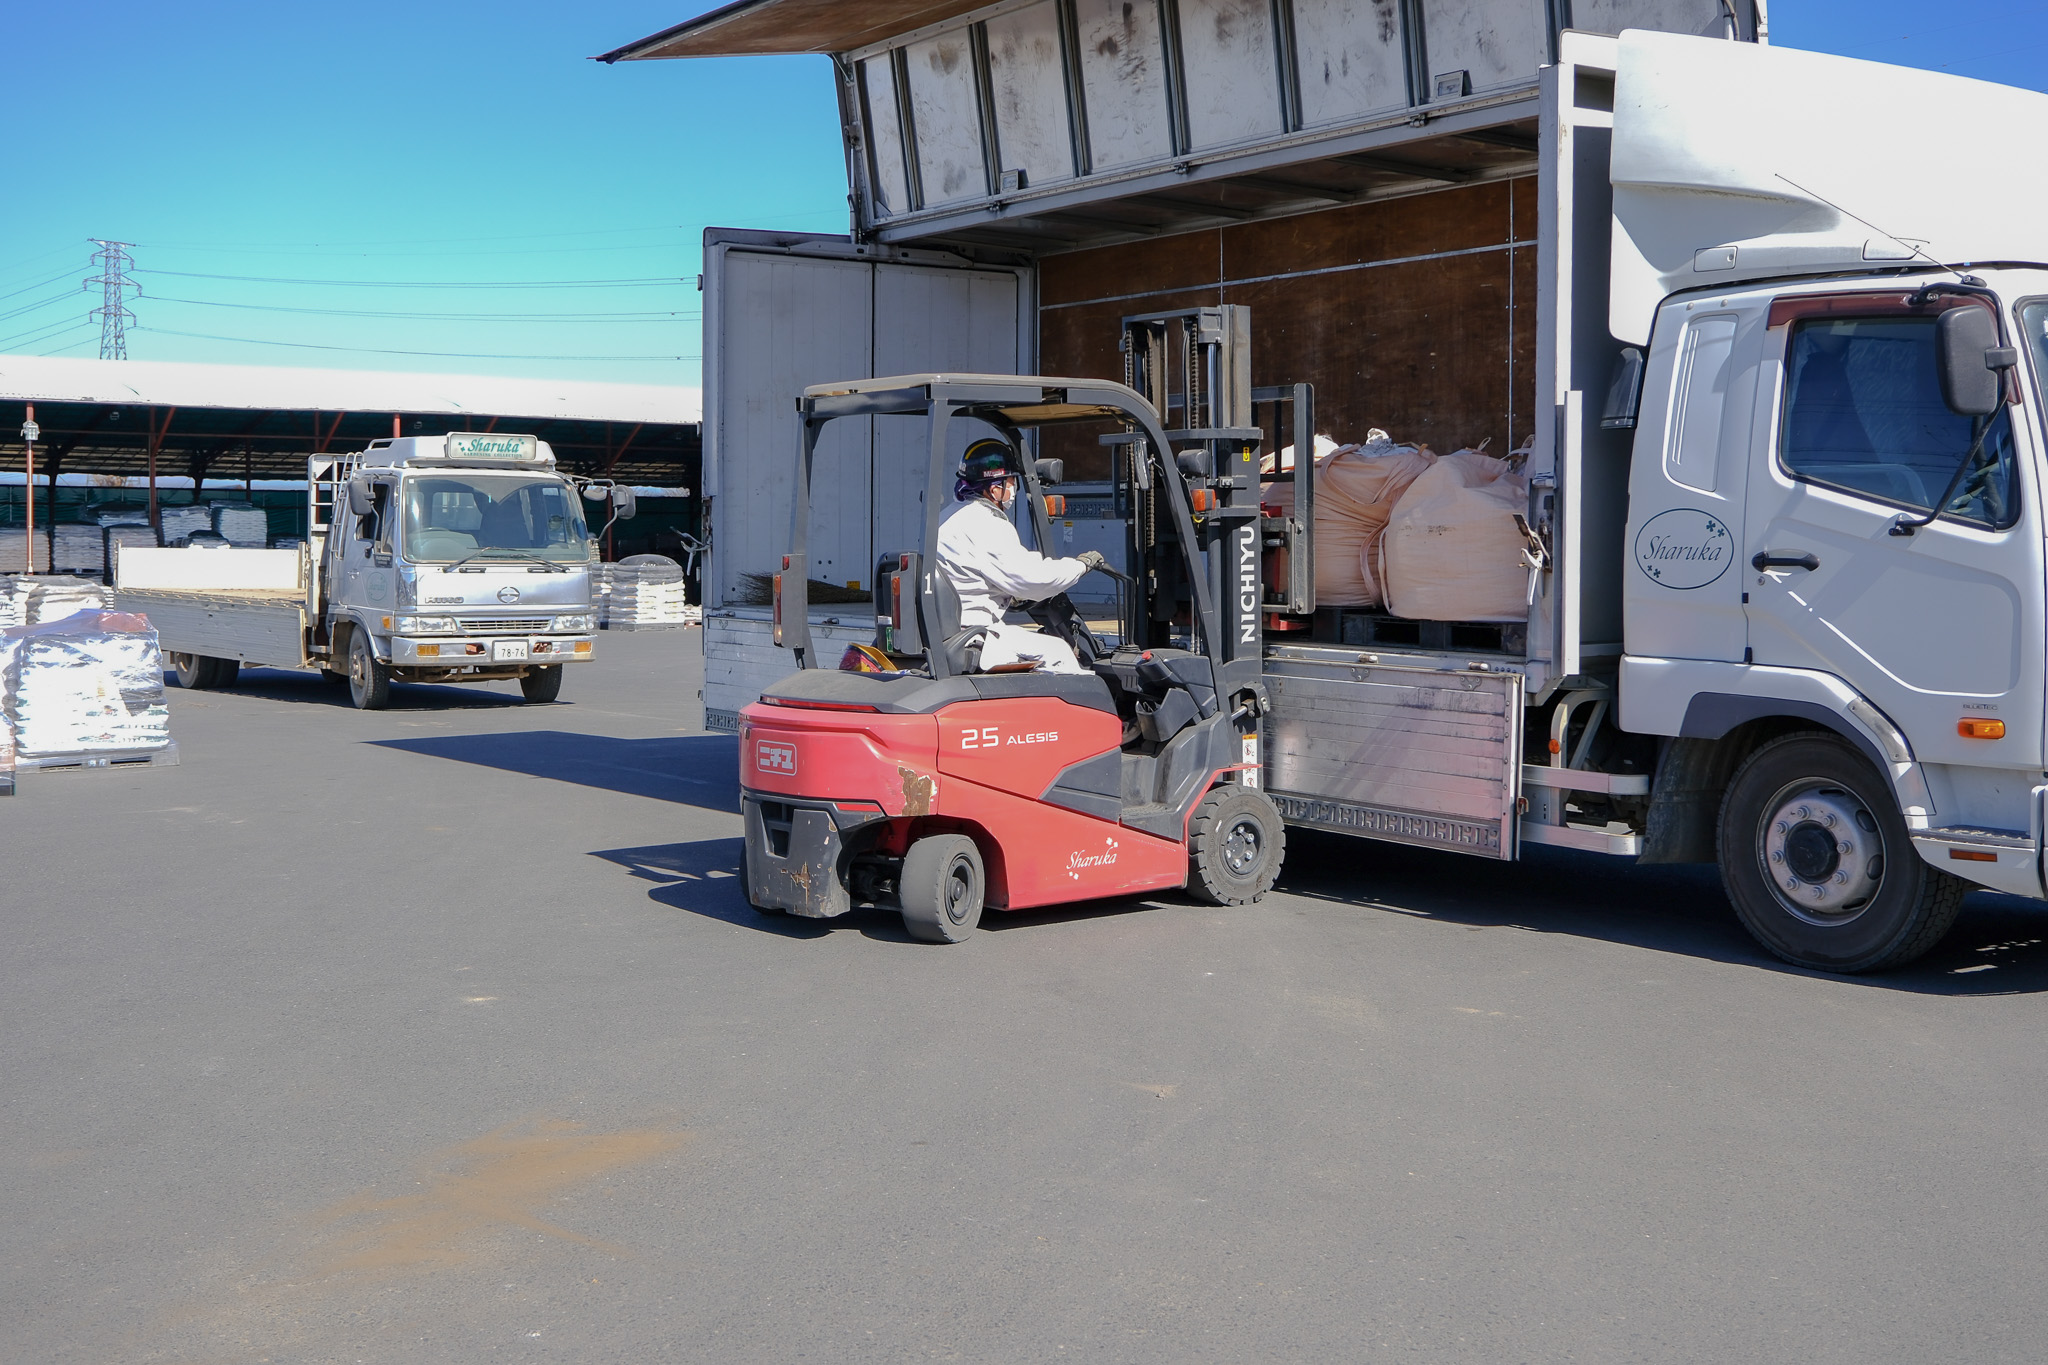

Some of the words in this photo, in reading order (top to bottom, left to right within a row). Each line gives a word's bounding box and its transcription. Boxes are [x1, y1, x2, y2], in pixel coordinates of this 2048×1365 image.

[468, 437, 520, 453] Sharuka
[1643, 535, 1722, 561] Sharuka
[924, 572, 933, 595] 1
[1240, 526, 1255, 644] NICHIYU
[501, 648, 525, 658] 78-76
[961, 727, 999, 749] 25
[1006, 732, 1058, 745] ALESIS
[1066, 846, 1118, 870] Sharuka
